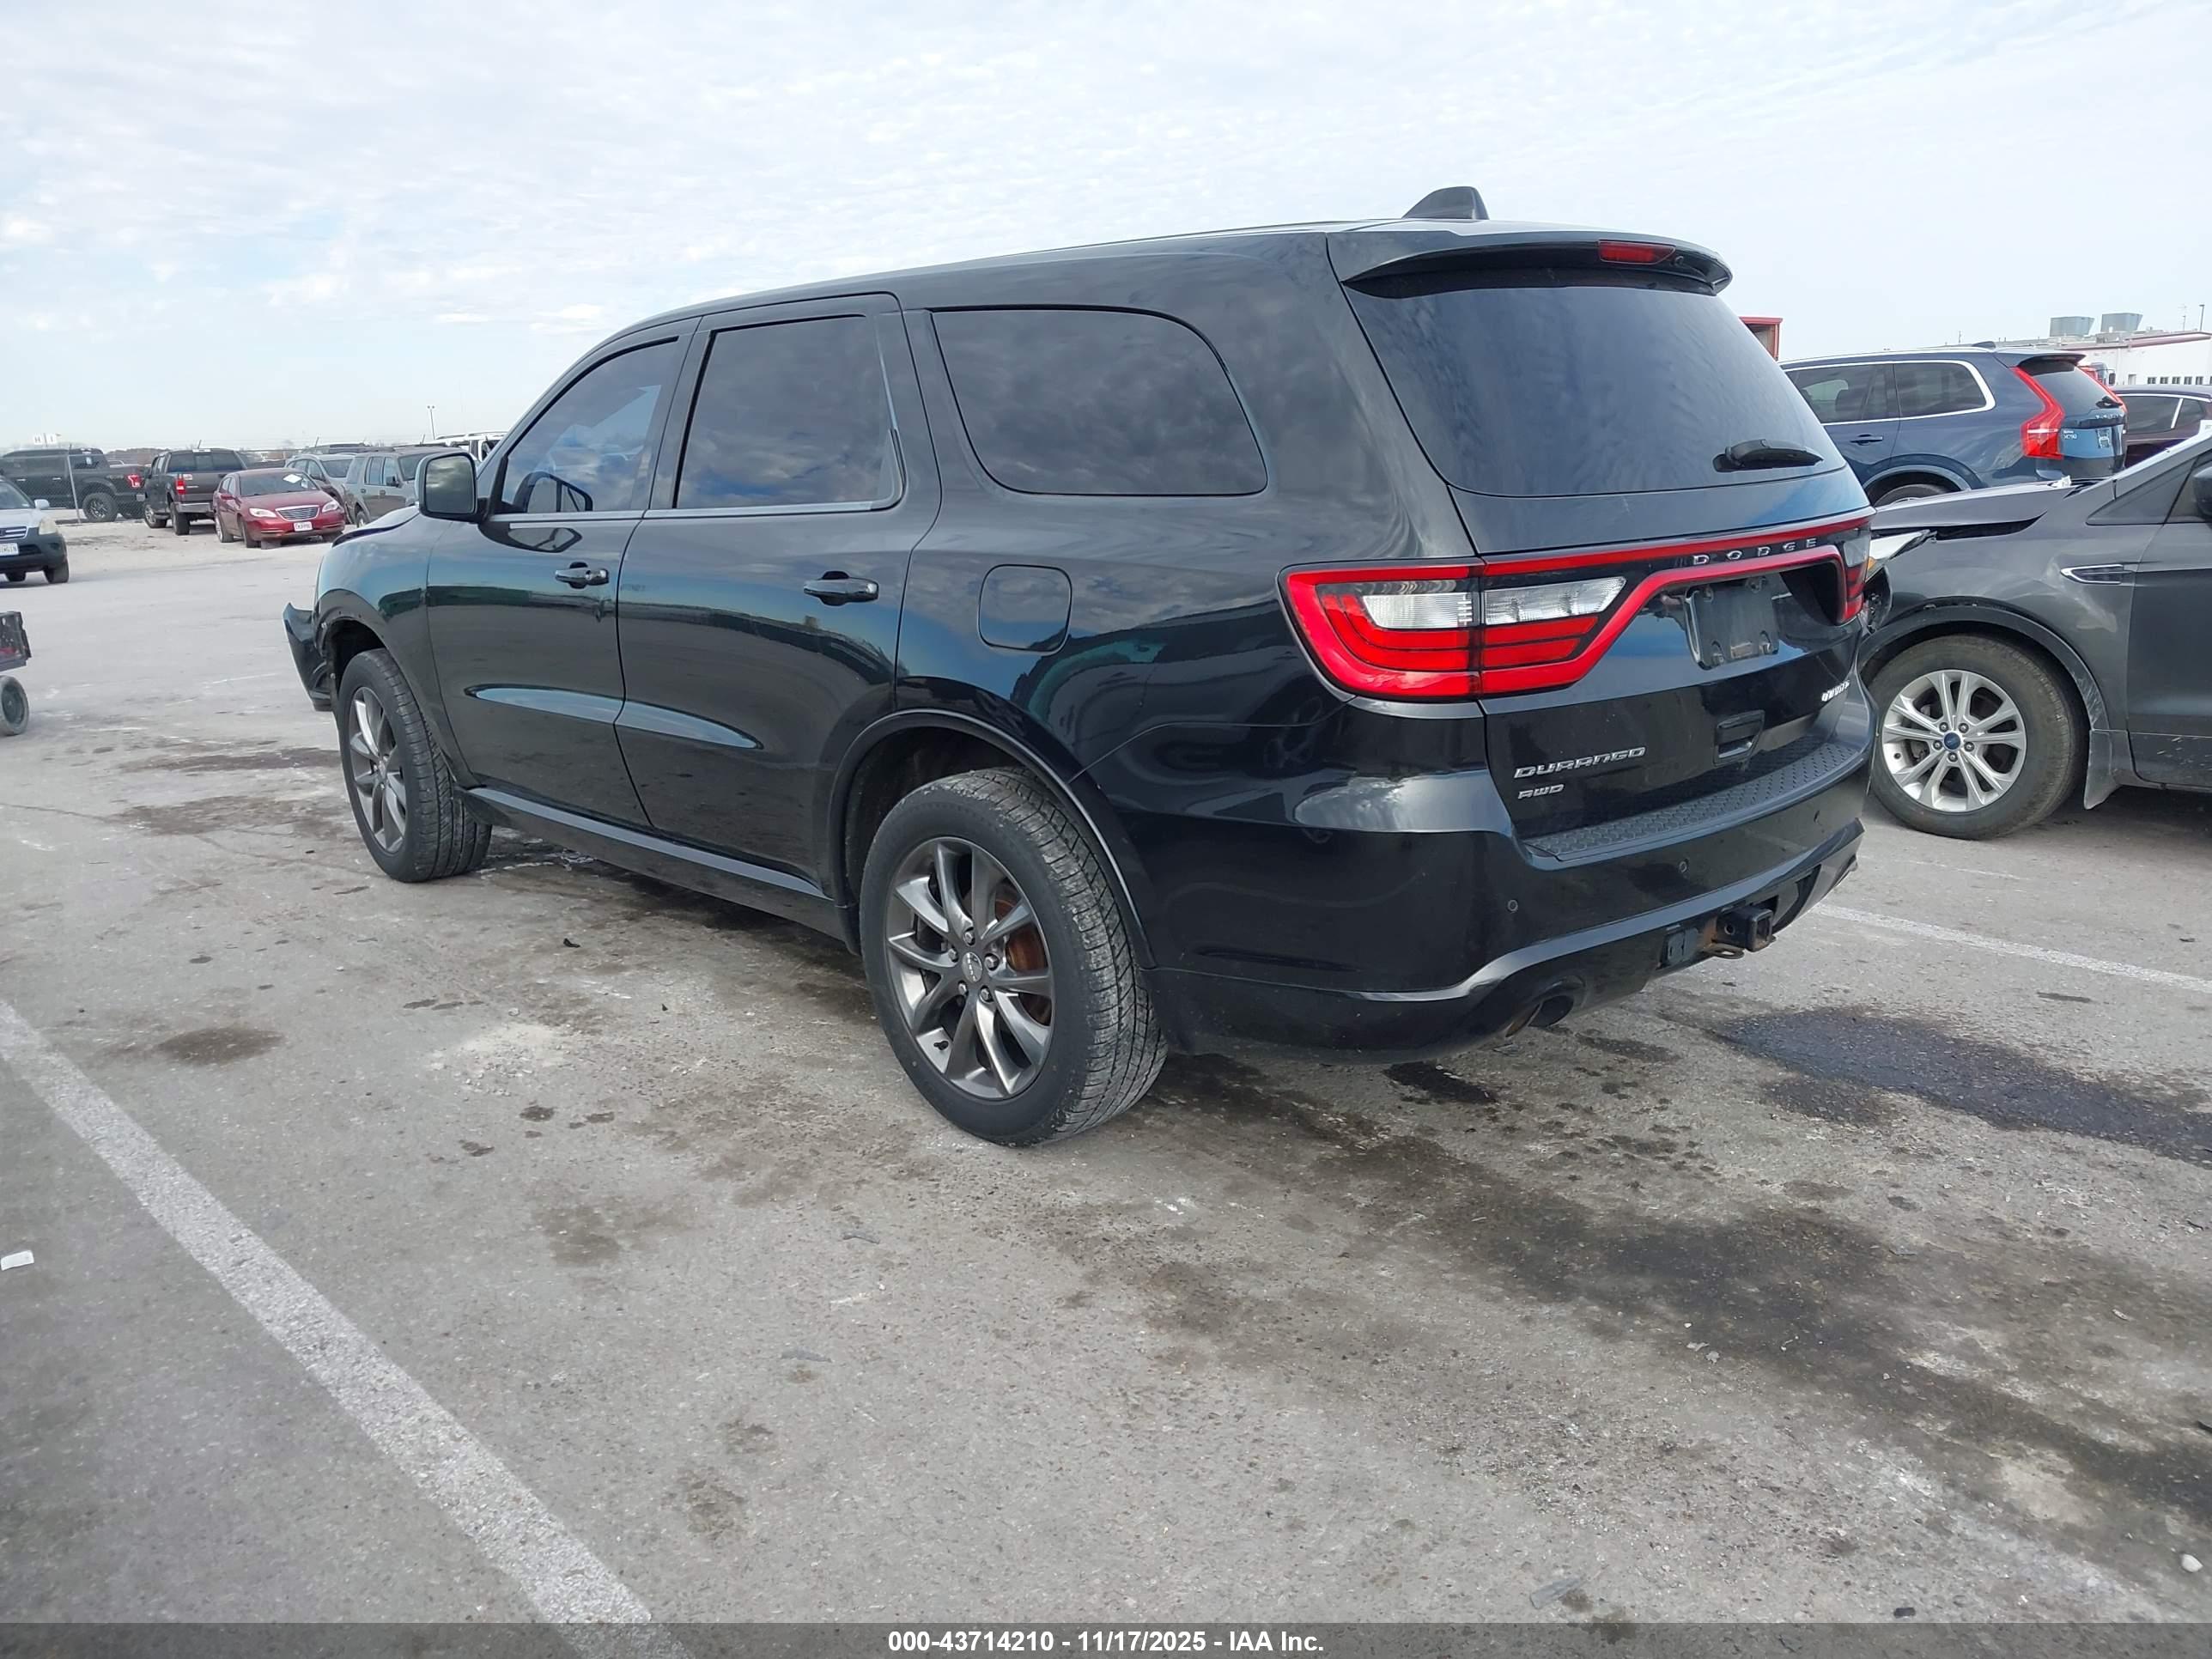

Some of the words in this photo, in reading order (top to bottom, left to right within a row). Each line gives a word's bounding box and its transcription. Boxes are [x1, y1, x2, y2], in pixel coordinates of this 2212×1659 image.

[1692, 538, 1817, 565] DODGE
[1513, 746, 1646, 779] DURANGO
[1517, 783, 1565, 799] AWD
